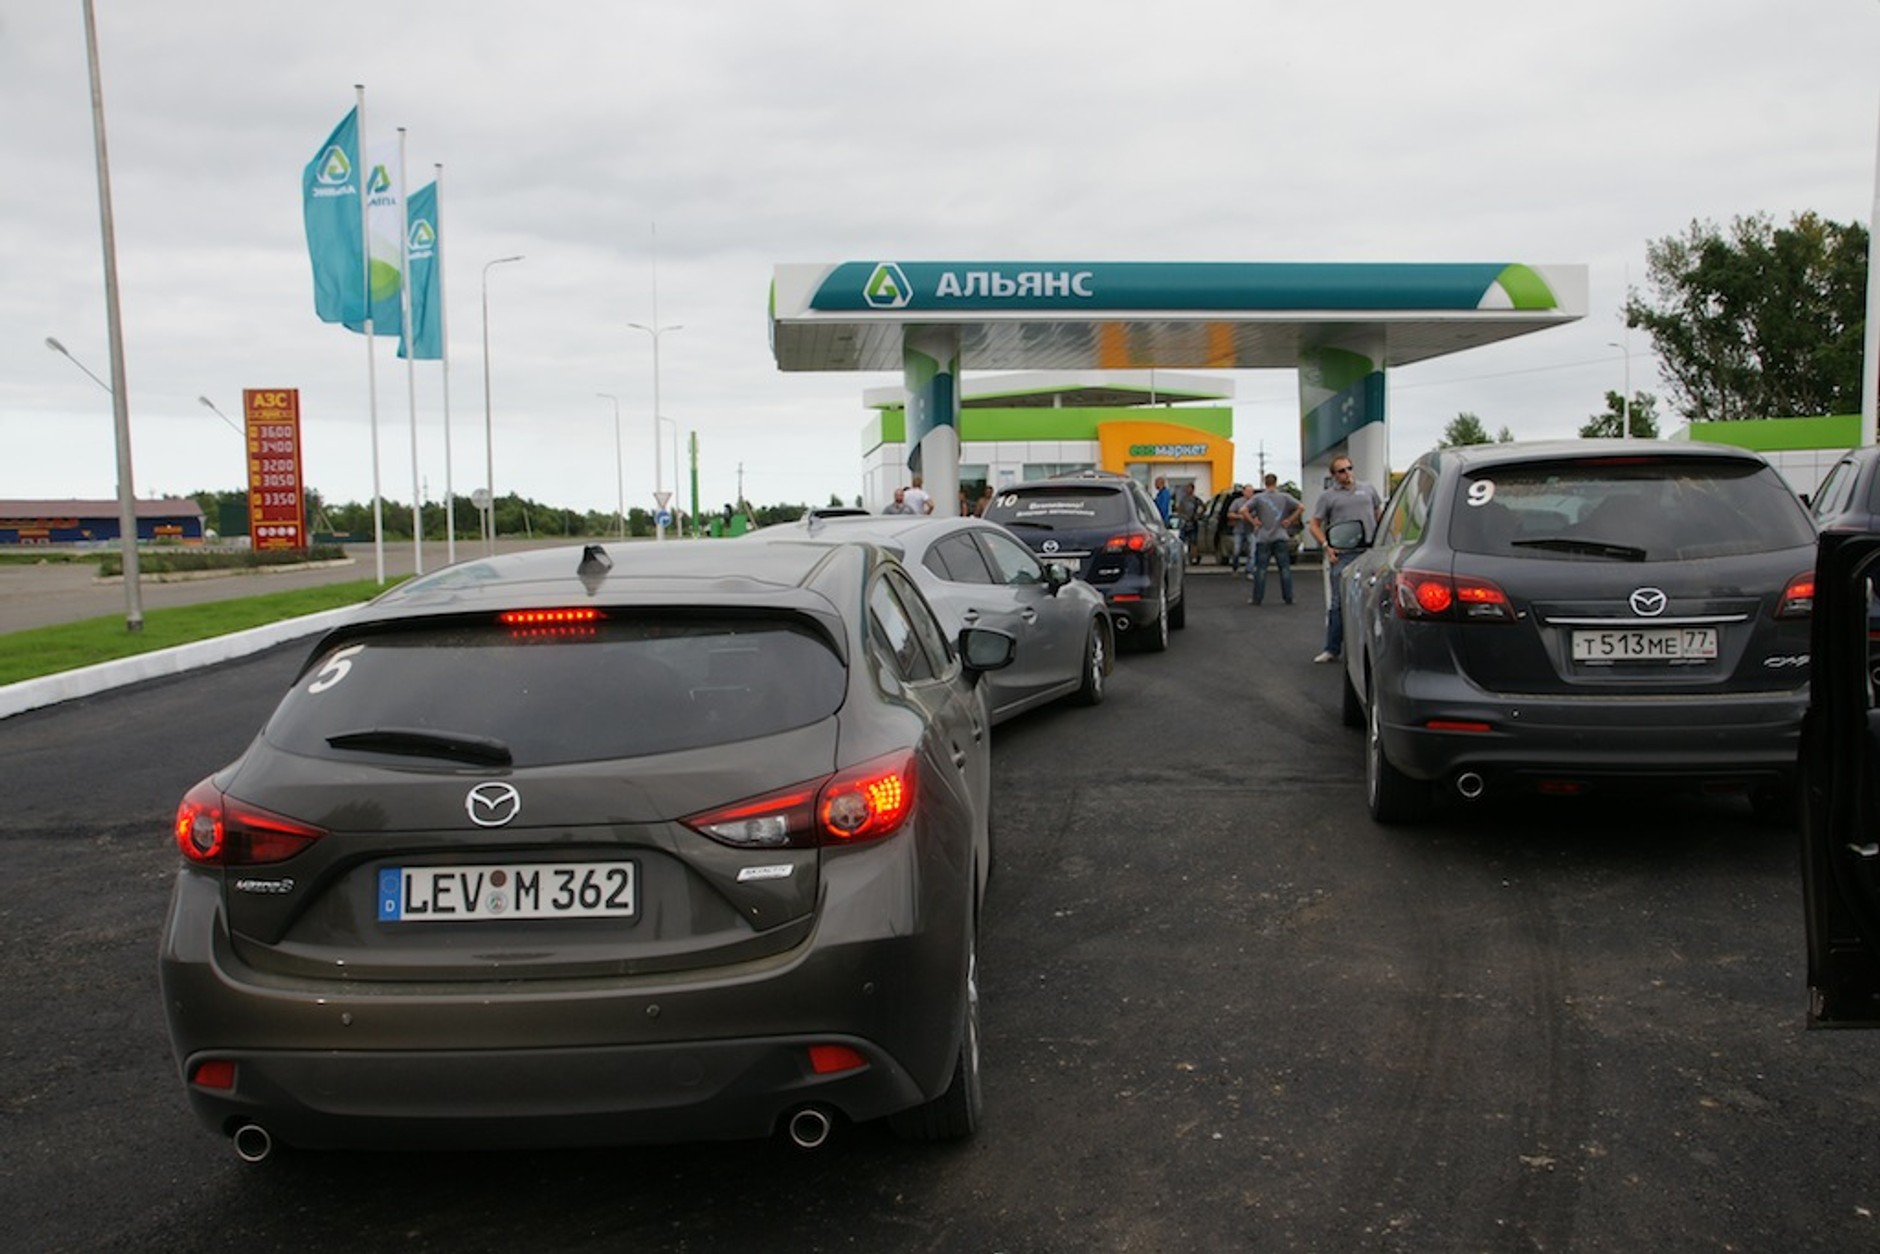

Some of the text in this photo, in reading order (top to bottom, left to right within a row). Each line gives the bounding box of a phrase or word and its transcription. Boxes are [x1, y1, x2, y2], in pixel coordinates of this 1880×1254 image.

[935, 271, 1094, 298] АЛЬЯНС
[253, 392, 288, 408] АЗС
[996, 494, 1018, 508] 10
[1467, 479, 1495, 507] 9
[1685, 632, 1707, 648] 77
[308, 644, 365, 694] 5
[404, 868, 629, 914] LEV M 362
[385, 900, 395, 912] D
